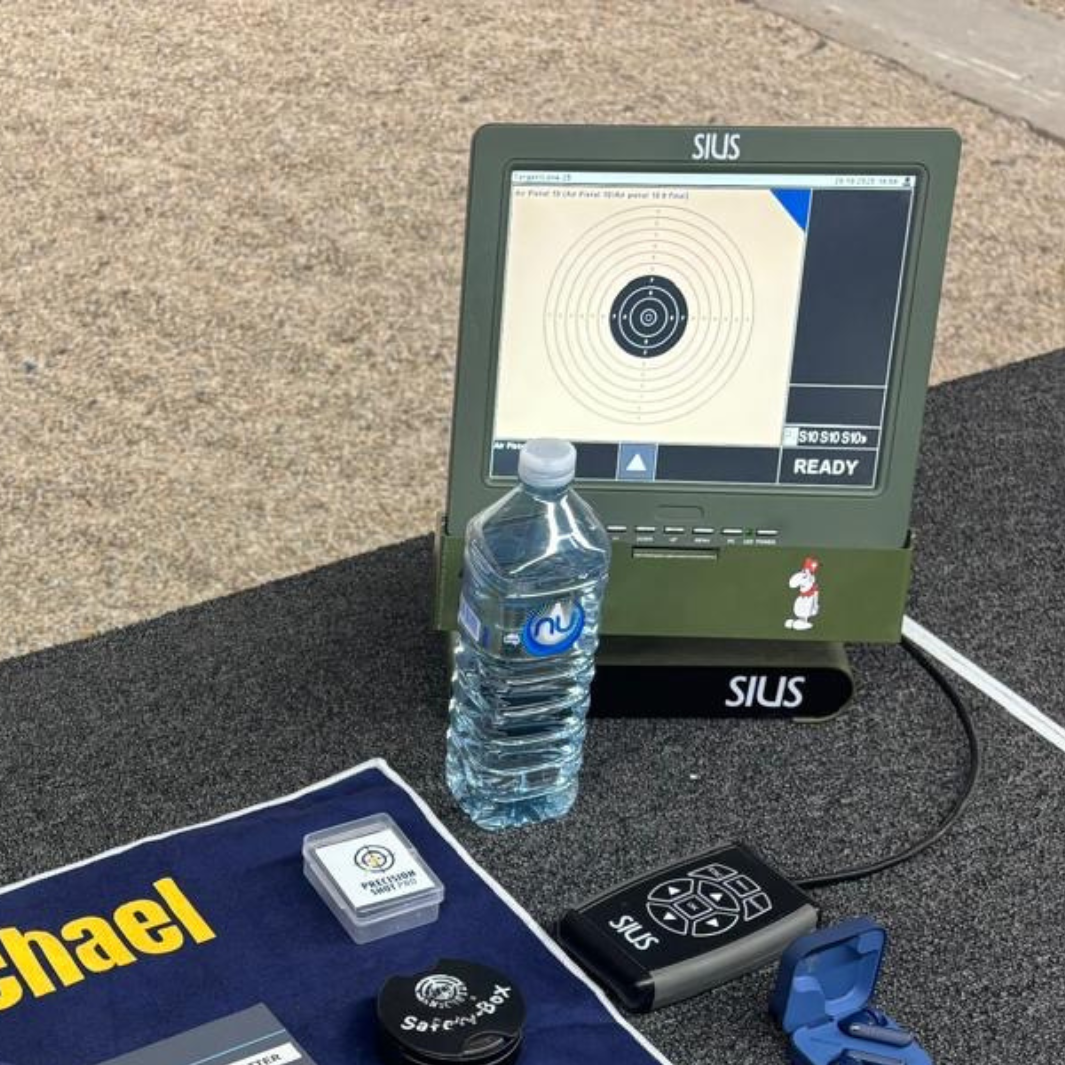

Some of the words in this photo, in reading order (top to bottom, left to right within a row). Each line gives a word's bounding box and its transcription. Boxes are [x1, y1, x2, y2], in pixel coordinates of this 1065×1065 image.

[692, 133, 741, 161] SIUS
[793, 458, 860, 477] READY
[725, 675, 807, 708] SIUS
[360, 869, 417, 891] PRECISION
[370, 885, 397, 896] SHOT
[609, 914, 660, 951] SIUS
